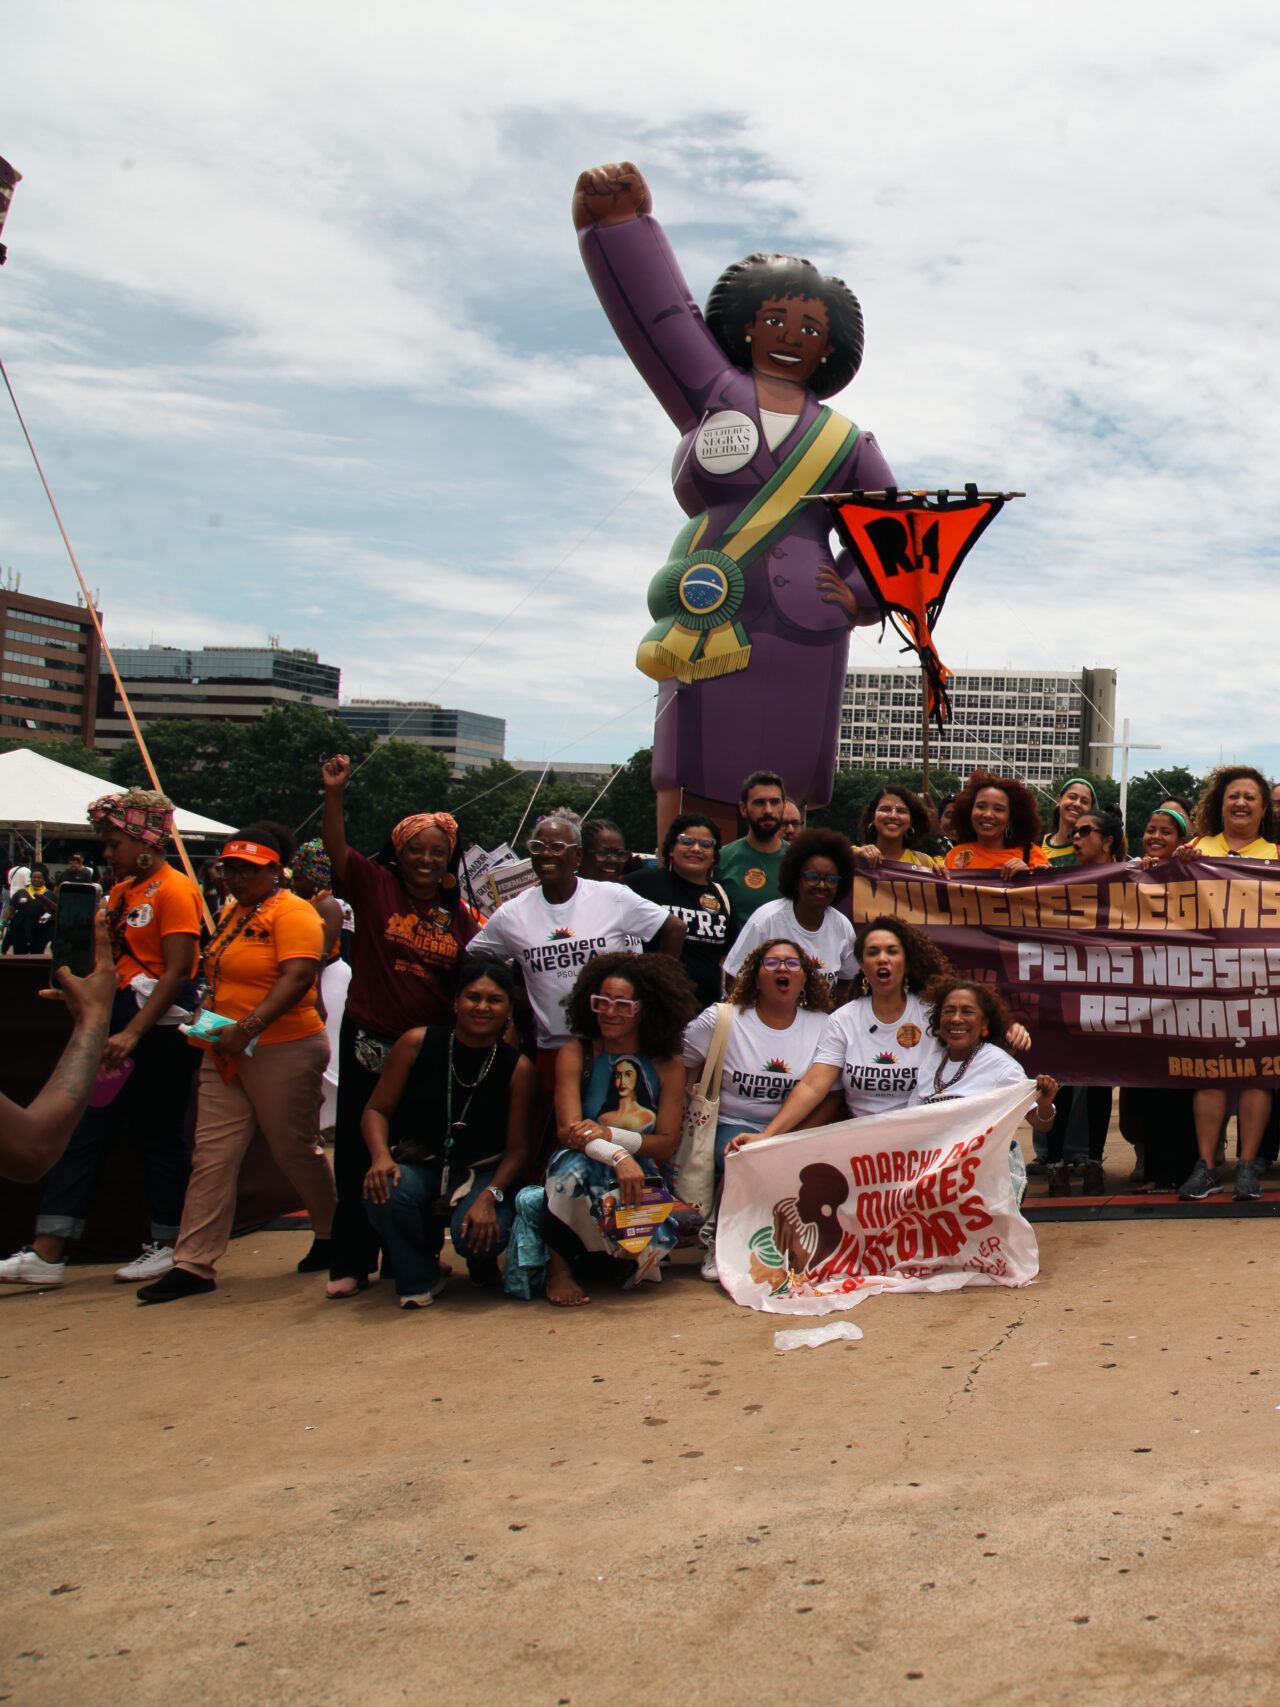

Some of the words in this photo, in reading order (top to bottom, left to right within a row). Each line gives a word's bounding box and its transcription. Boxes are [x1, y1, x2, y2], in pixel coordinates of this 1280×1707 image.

[702, 444, 749, 456] DECIDEM
[704, 435, 750, 447] NEGRAS
[853, 876, 1098, 929] MULHERES
[661, 905, 727, 937] FRJ
[523, 937, 607, 962] primavera
[1017, 942, 1134, 986] PELAS
[846, 1063, 920, 1079] primaver
[1168, 1055, 1257, 1078] BRASÍLIA
[732, 1070, 801, 1089] primav
[850, 1075, 918, 1092] NEGRA
[738, 1084, 792, 1100] NEG
[850, 1148, 942, 1187] MARCHA
